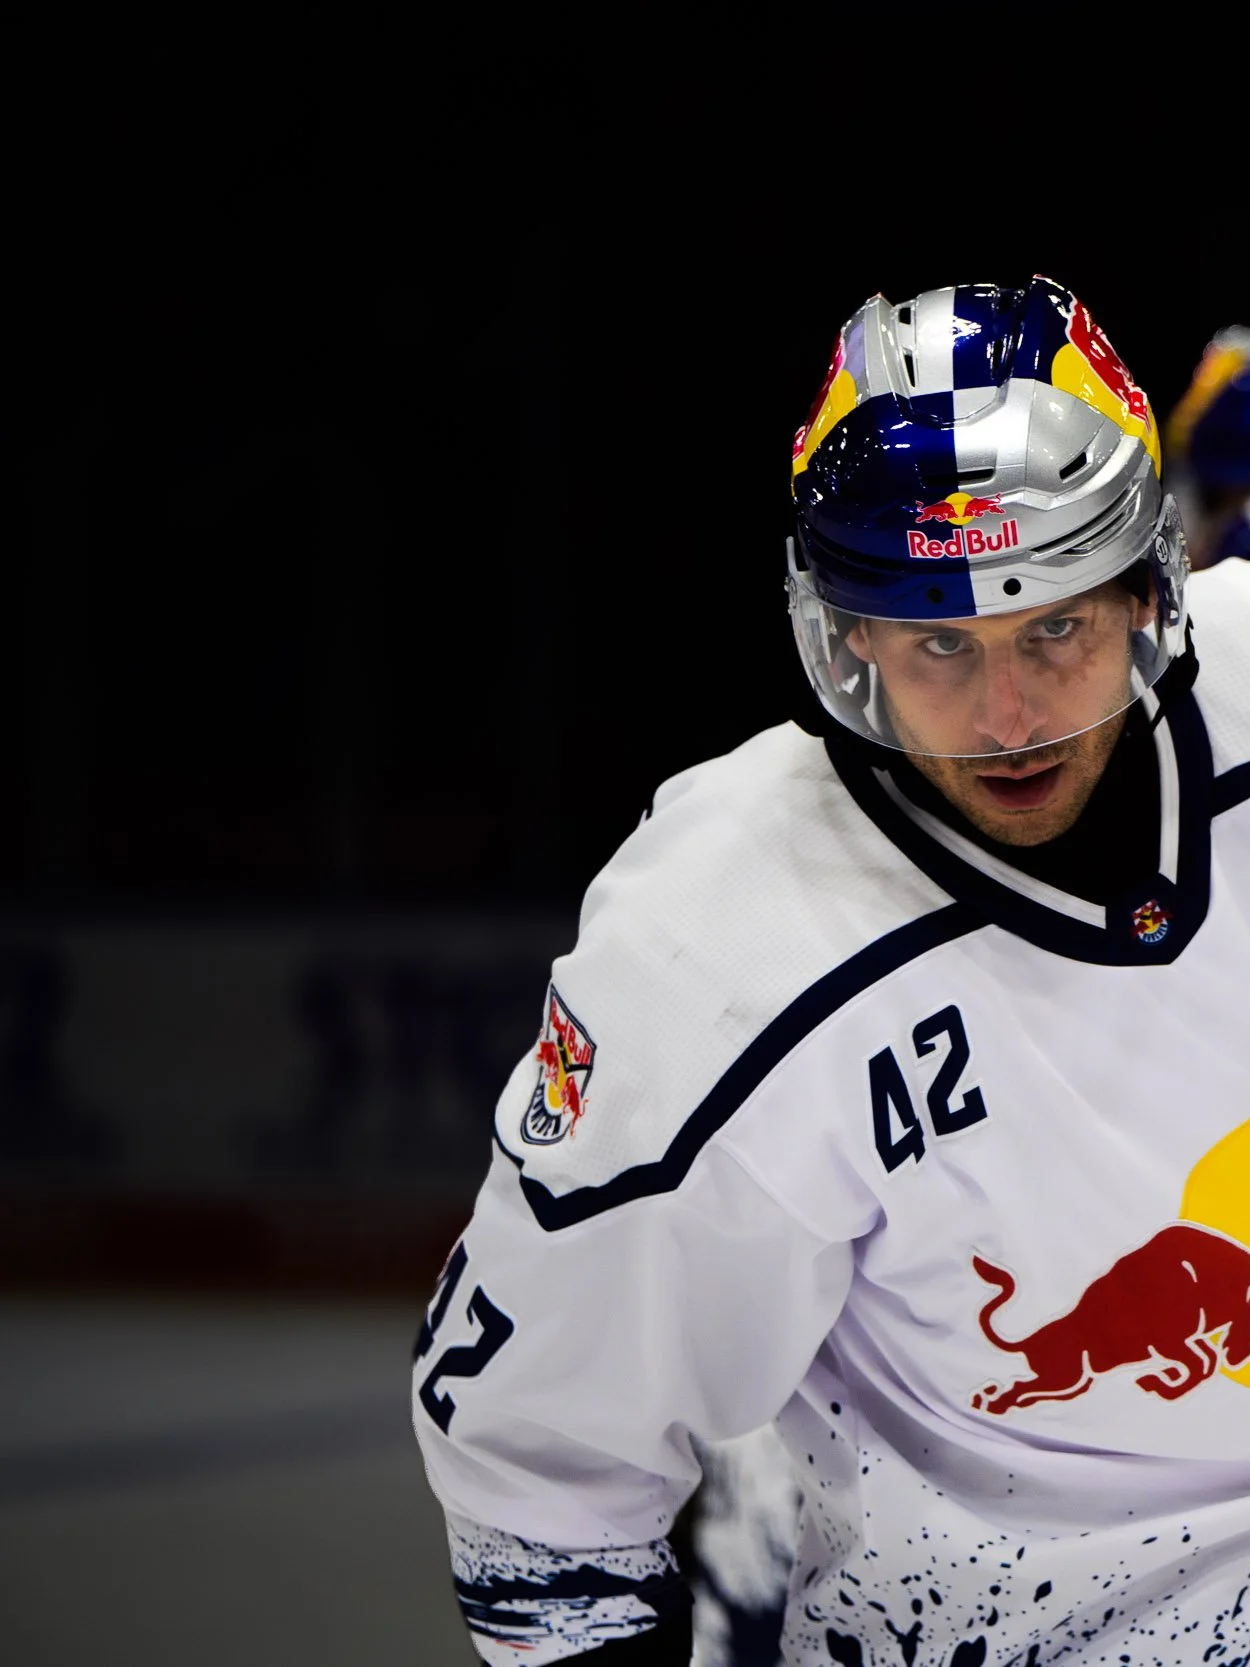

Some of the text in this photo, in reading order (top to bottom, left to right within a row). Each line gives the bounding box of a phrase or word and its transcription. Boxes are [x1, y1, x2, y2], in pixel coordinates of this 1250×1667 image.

[907, 519, 1019, 559] Red Bull
[568, 1025, 591, 1065] Bull
[868, 1004, 988, 1174] 42
